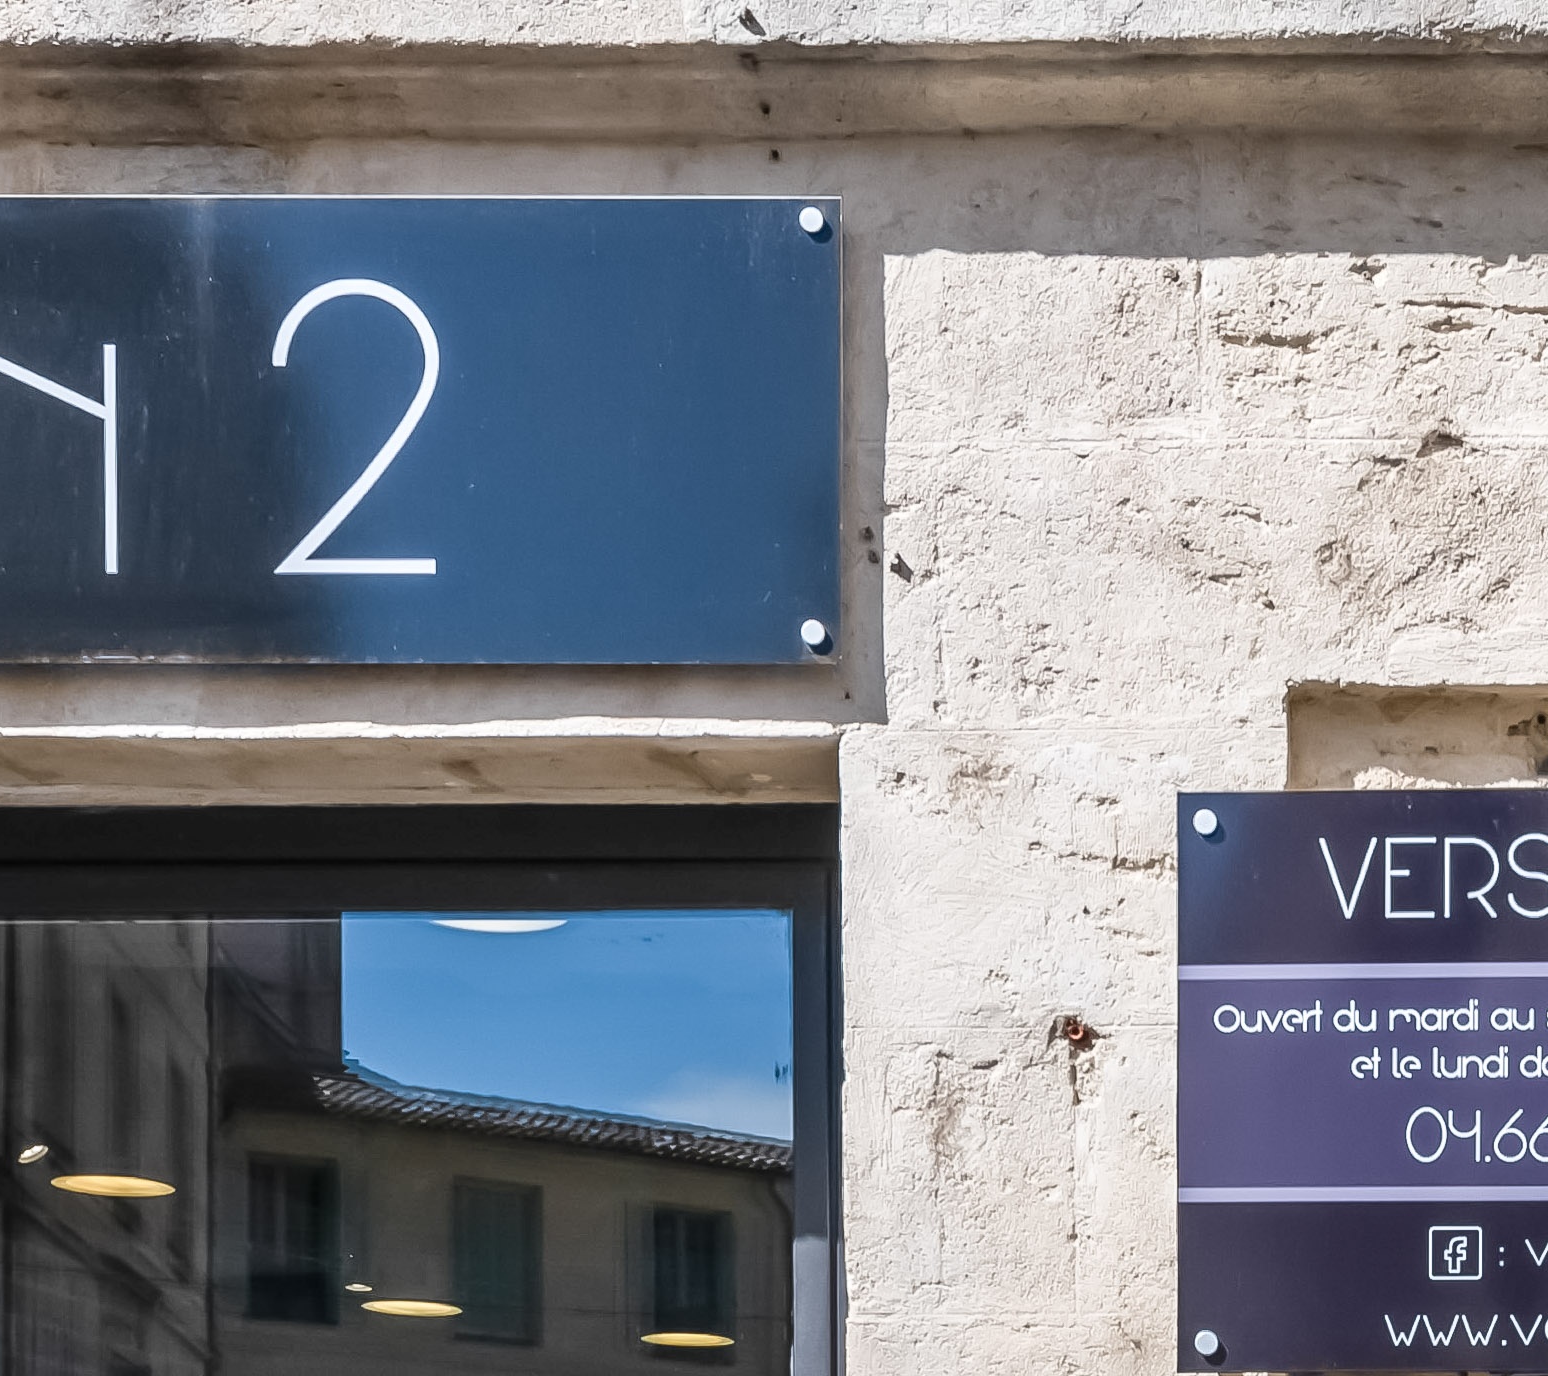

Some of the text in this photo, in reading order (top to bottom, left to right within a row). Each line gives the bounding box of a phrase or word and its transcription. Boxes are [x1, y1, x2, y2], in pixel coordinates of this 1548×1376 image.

[270, 277, 441, 576] 2
[1213, 999, 1324, 1034] Ouvert
[1332, 999, 1377, 1033] du
[1388, 998, 1479, 1032] mardi
[1490, 1007, 1535, 1031] au
[1350, 1046, 1382, 1079] et
[1391, 1047, 1422, 1079] le
[1432, 1045, 1509, 1079] lundi
